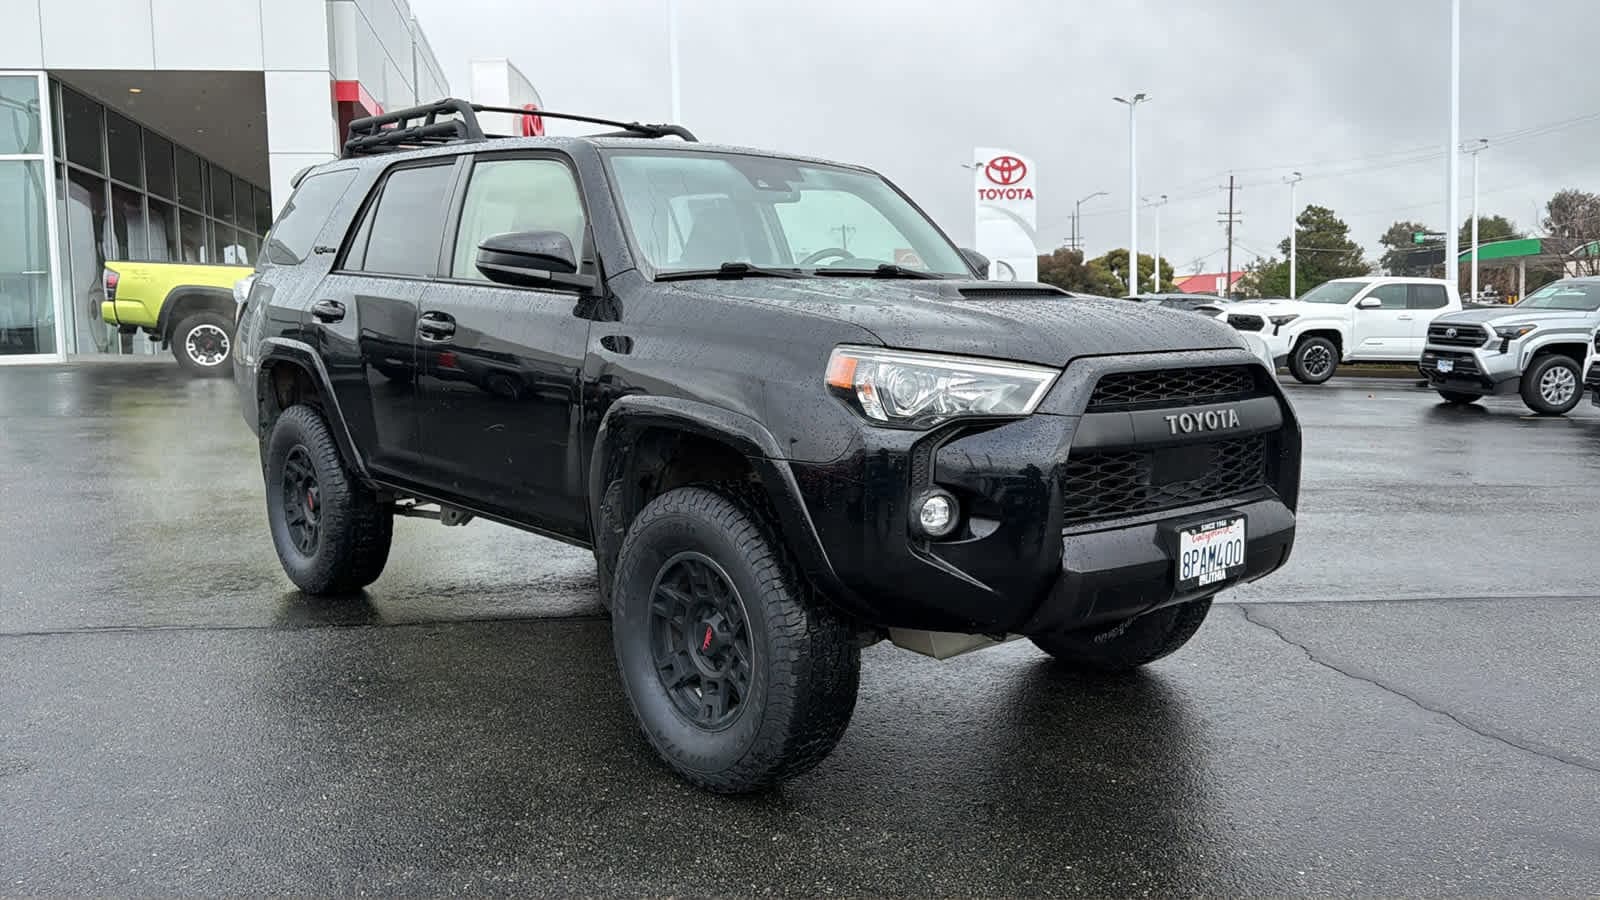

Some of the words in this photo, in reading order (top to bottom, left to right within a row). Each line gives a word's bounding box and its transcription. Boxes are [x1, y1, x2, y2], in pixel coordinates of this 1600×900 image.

[978, 188, 1034, 200] TOYOTA
[1166, 408, 1240, 434] TOYOTA
[1183, 538, 1242, 578] 8PAM400
